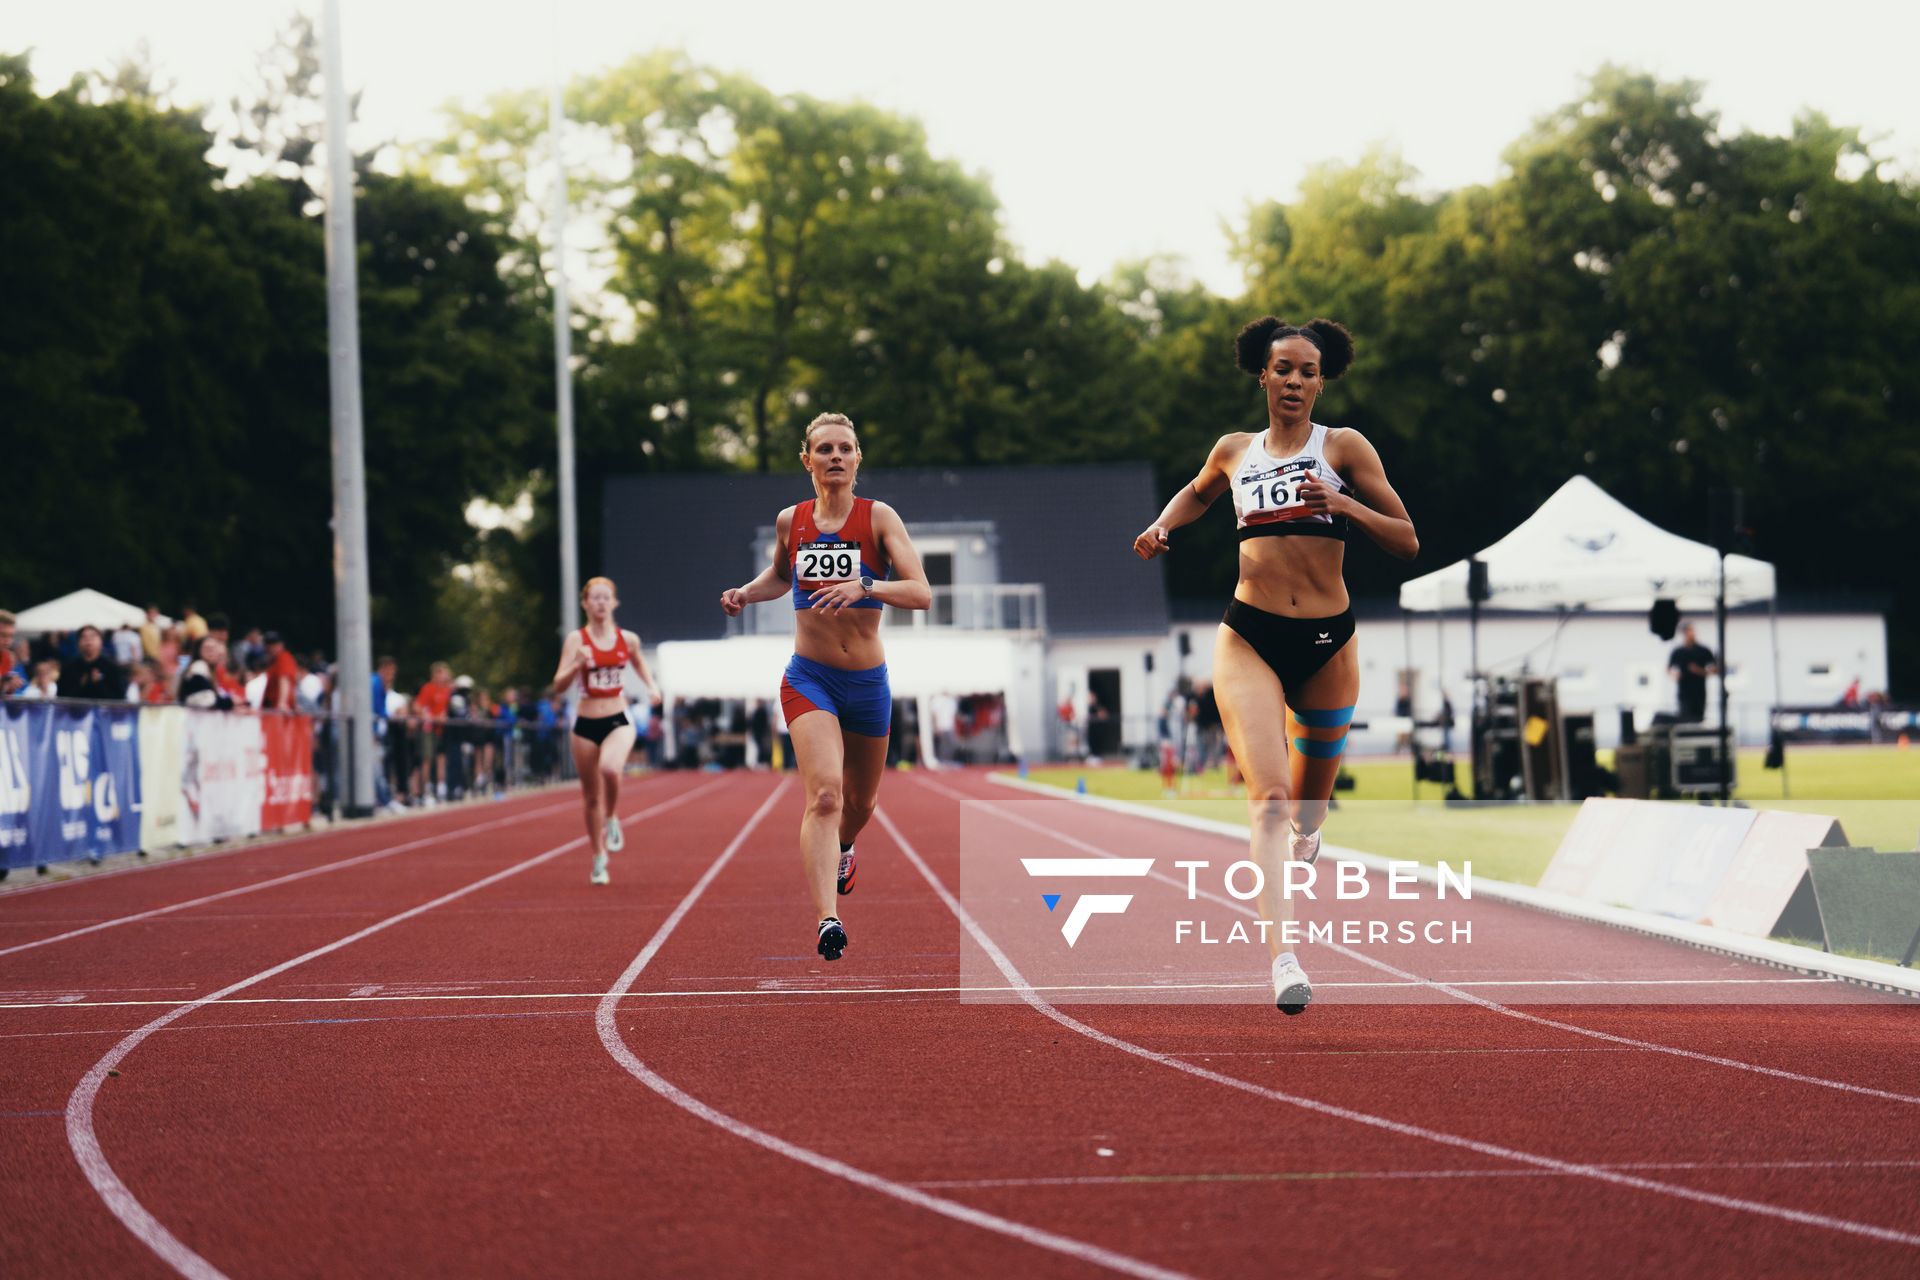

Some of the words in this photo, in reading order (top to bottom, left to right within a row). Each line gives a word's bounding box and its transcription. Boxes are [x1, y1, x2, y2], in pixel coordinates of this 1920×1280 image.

[1257, 470, 1277, 480] JUMP
[1283, 463, 1299, 473] RUN
[803, 553, 852, 578] 299
